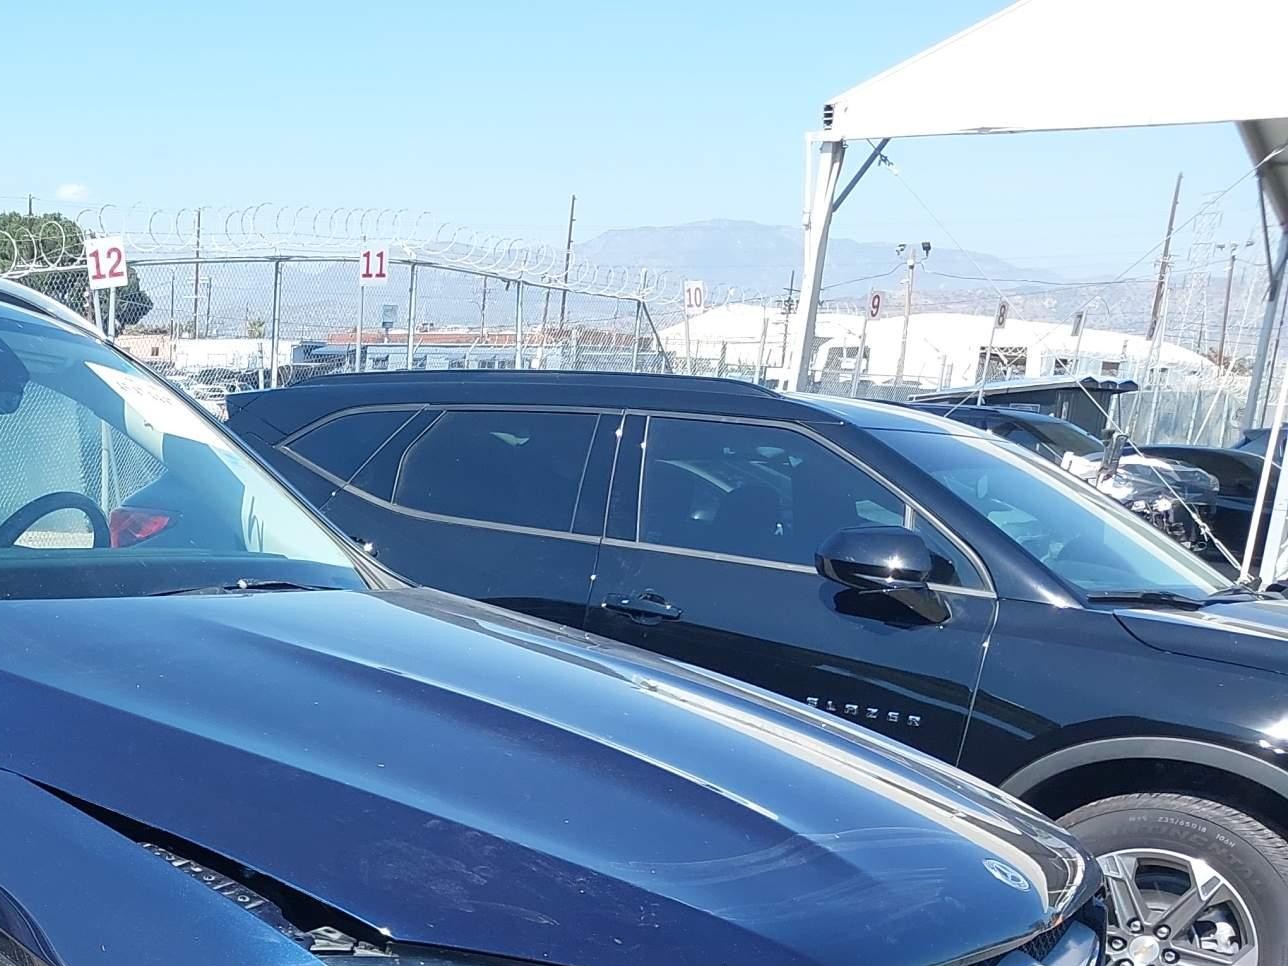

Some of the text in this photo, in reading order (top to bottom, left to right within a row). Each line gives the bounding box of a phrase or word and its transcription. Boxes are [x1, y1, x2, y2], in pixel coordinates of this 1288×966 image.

[88, 246, 125, 280] 12
[361, 250, 387, 278] 11
[686, 287, 702, 308] 10
[870, 294, 881, 318] 9
[997, 304, 1007, 326] 8
[806, 697, 921, 727] BLAZER
